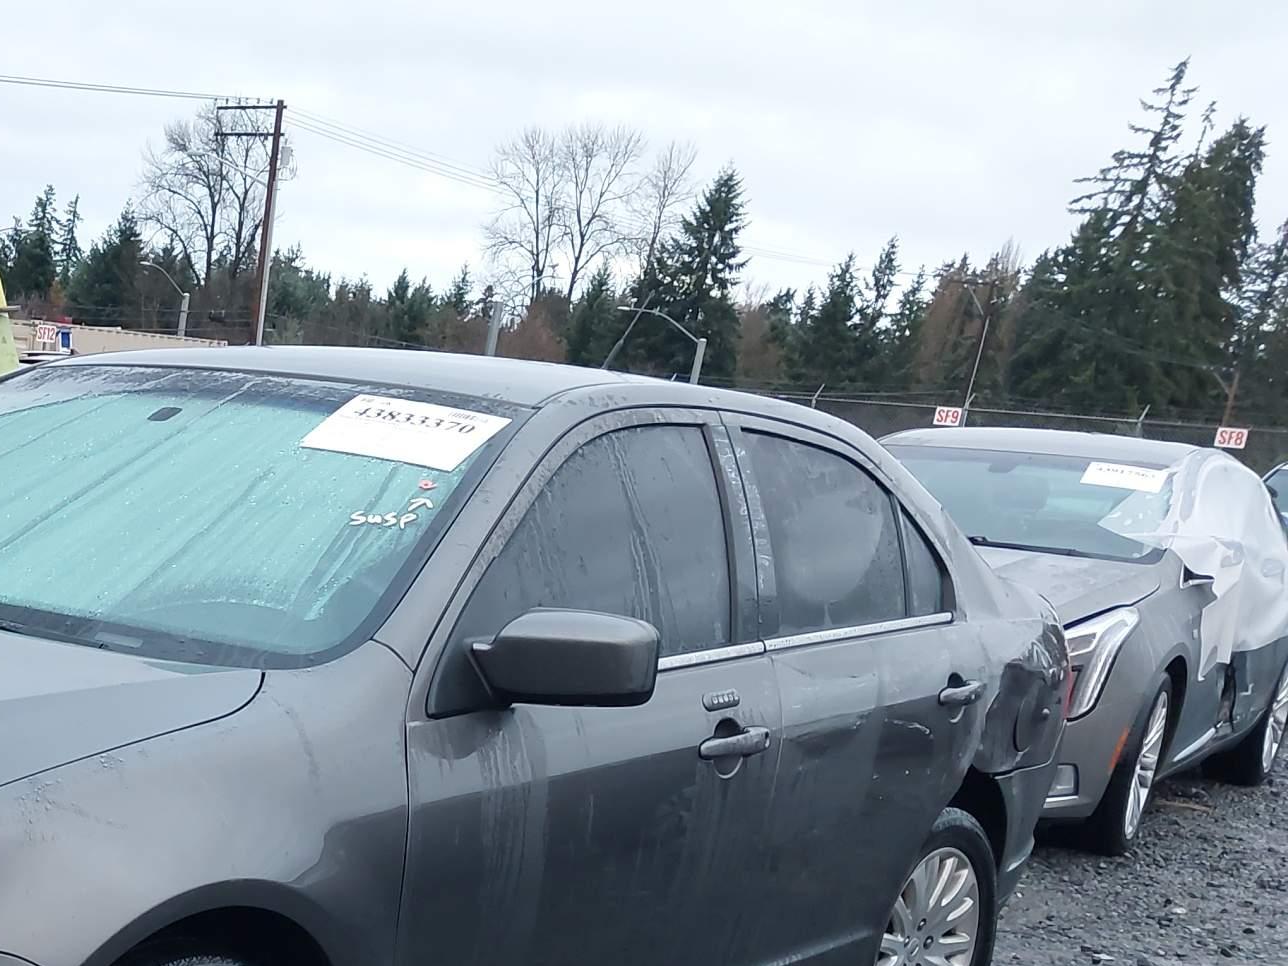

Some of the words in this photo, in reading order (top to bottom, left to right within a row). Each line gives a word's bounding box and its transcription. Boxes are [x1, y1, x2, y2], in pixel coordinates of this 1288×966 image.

[37, 326, 56, 341] SF12
[353, 407, 476, 434] 43833370
[936, 408, 960, 424] SF9
[1218, 430, 1244, 446] SF8
